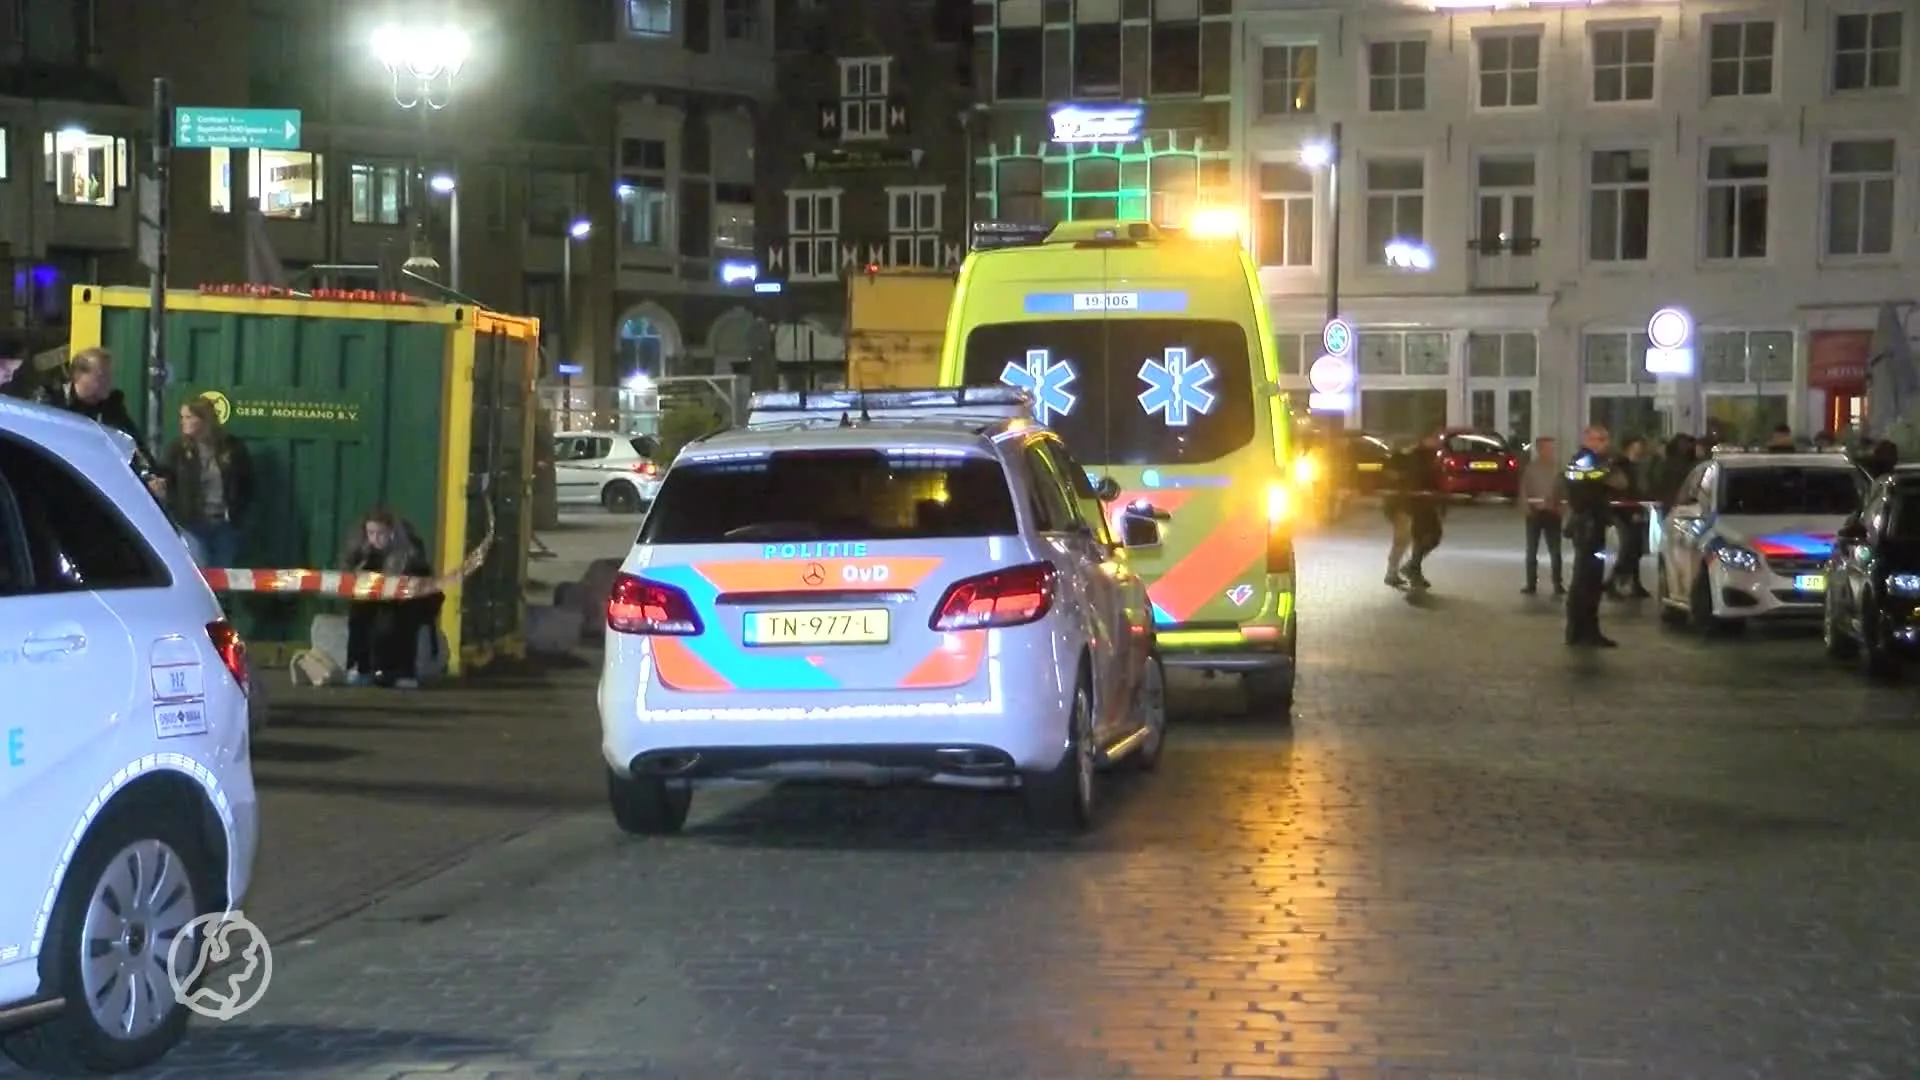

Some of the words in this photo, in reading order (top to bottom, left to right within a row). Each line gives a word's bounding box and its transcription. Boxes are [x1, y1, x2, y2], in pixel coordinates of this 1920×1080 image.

[1085, 296, 1129, 306] 19-106
[764, 543, 868, 559] POLITIE
[842, 565, 889, 582] OvD
[769, 615, 875, 636] TN-977-L
